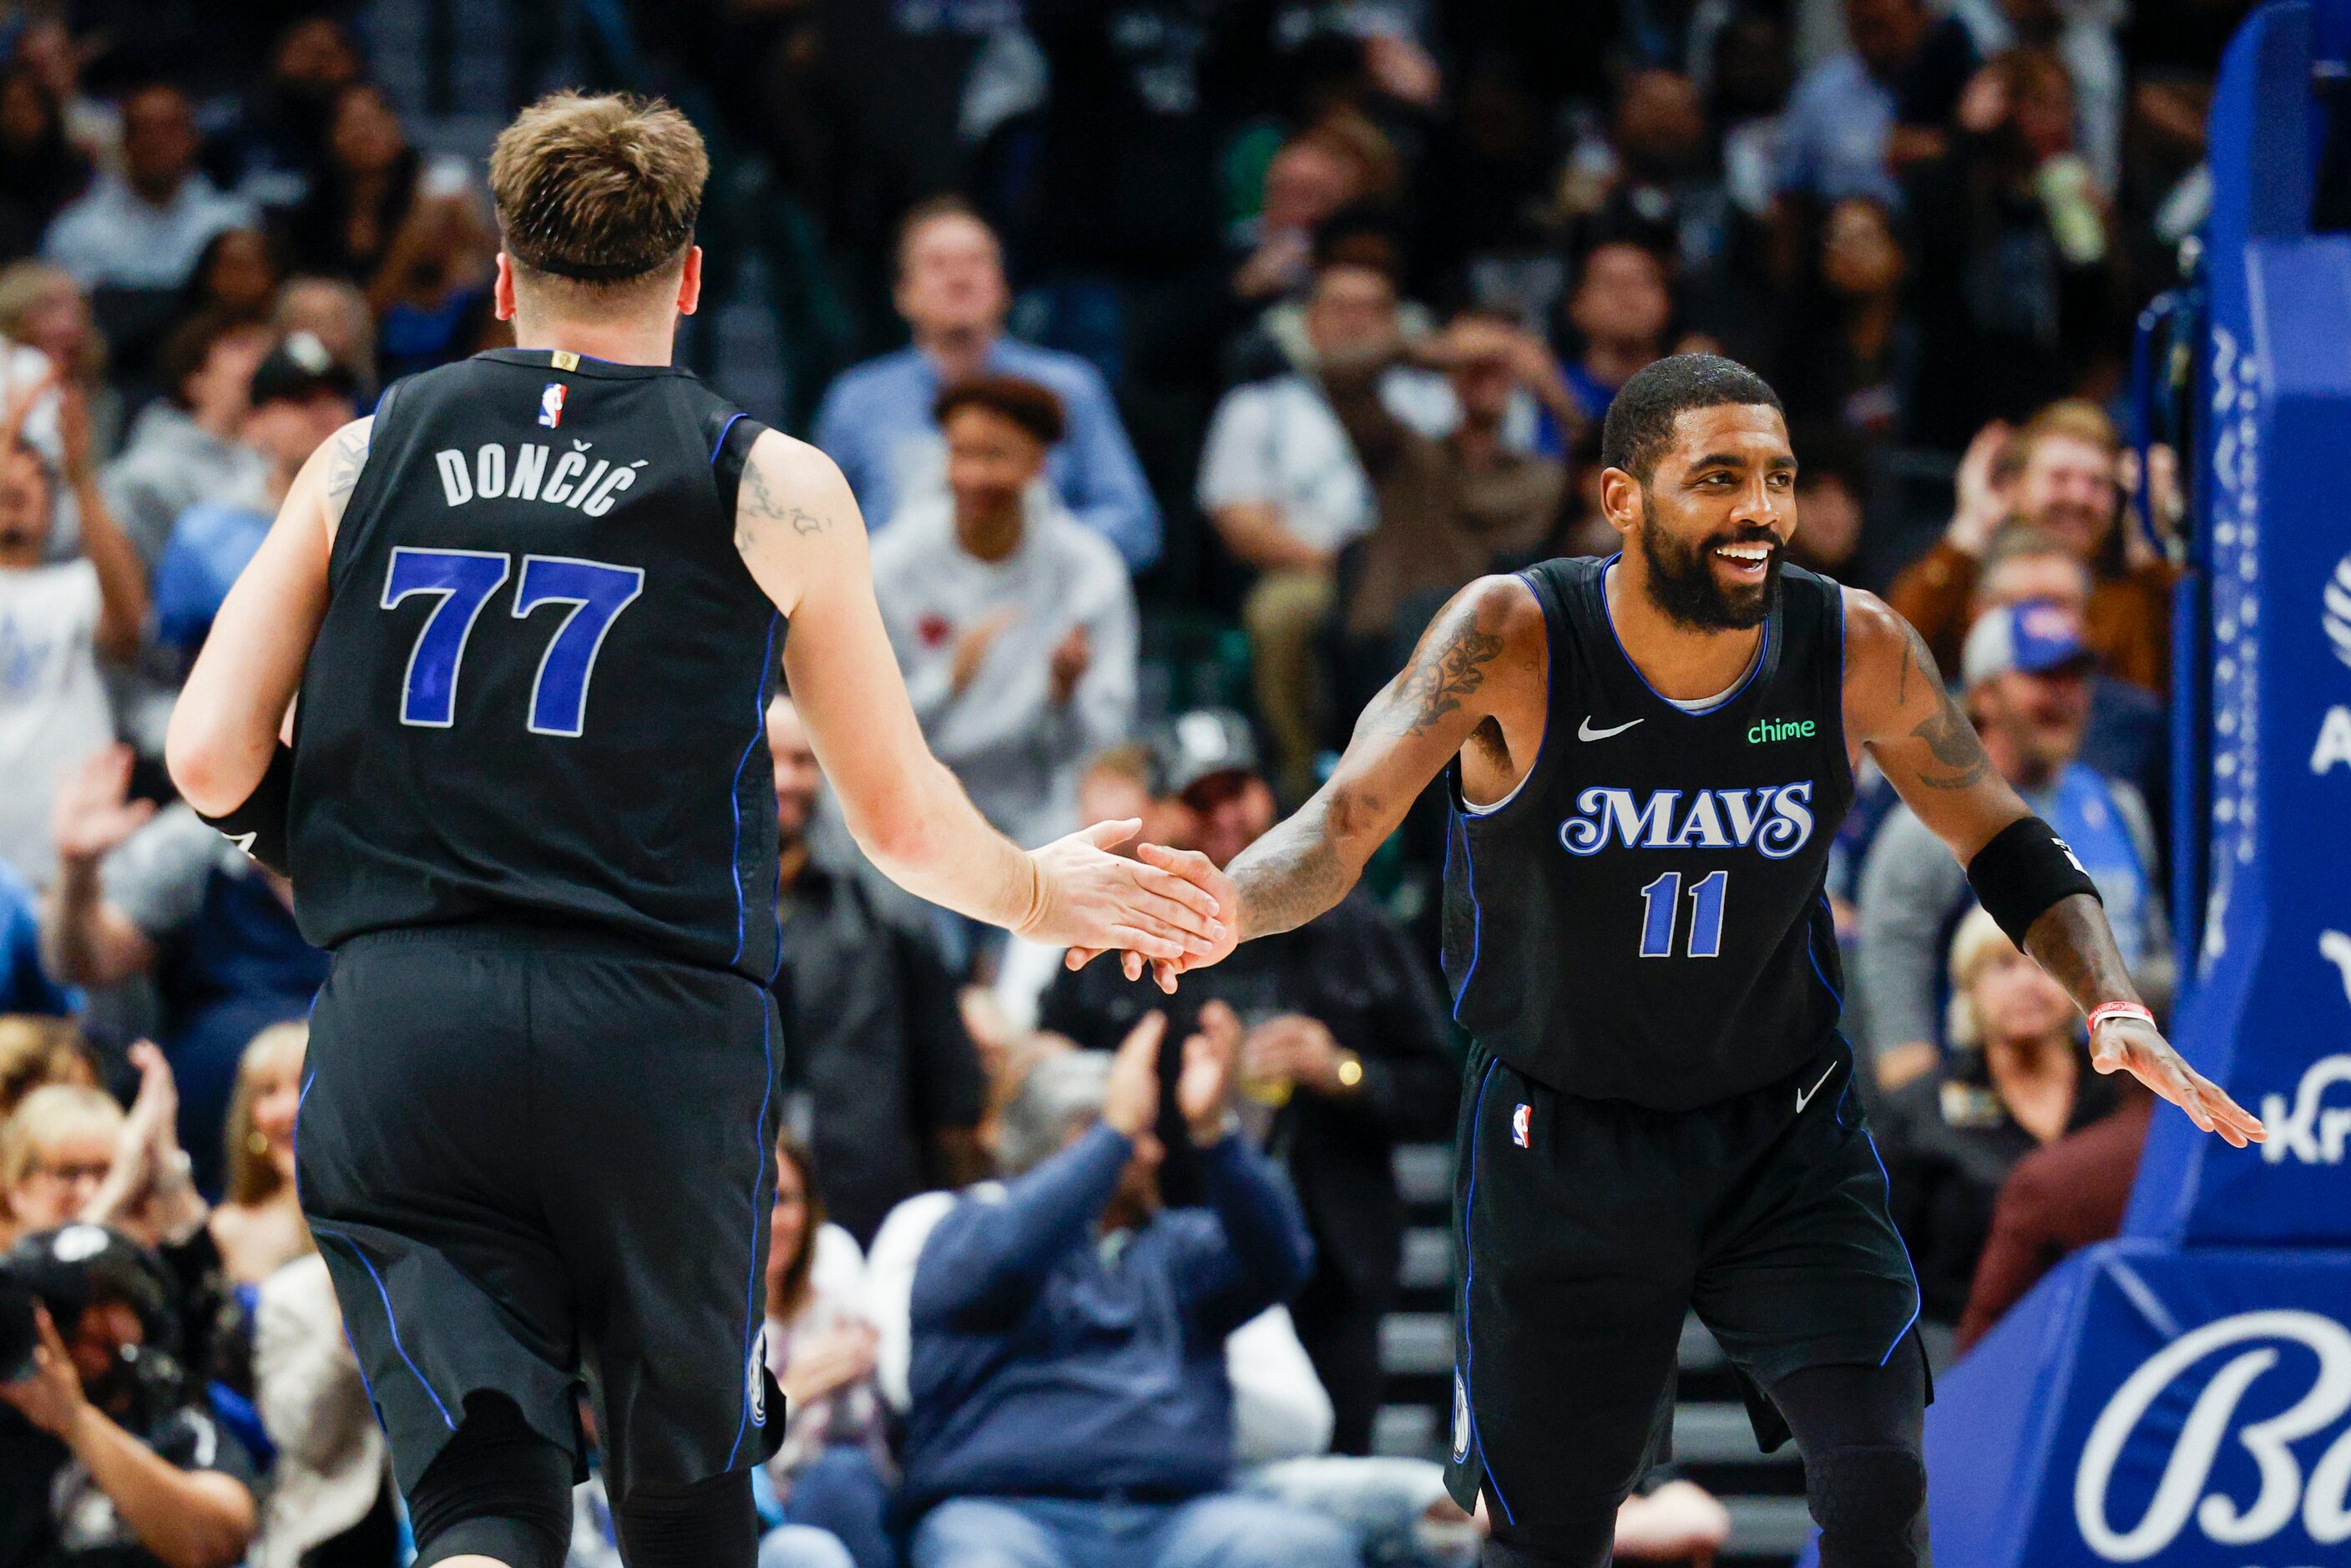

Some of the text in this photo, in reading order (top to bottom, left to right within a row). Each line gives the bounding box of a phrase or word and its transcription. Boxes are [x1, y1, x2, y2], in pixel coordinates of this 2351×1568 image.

[435, 439, 650, 518] DONČIĆ
[380, 546, 646, 738] 77
[1747, 718, 1816, 744] chime
[1559, 780, 1815, 860] MAVS
[1639, 870, 1728, 958] 11
